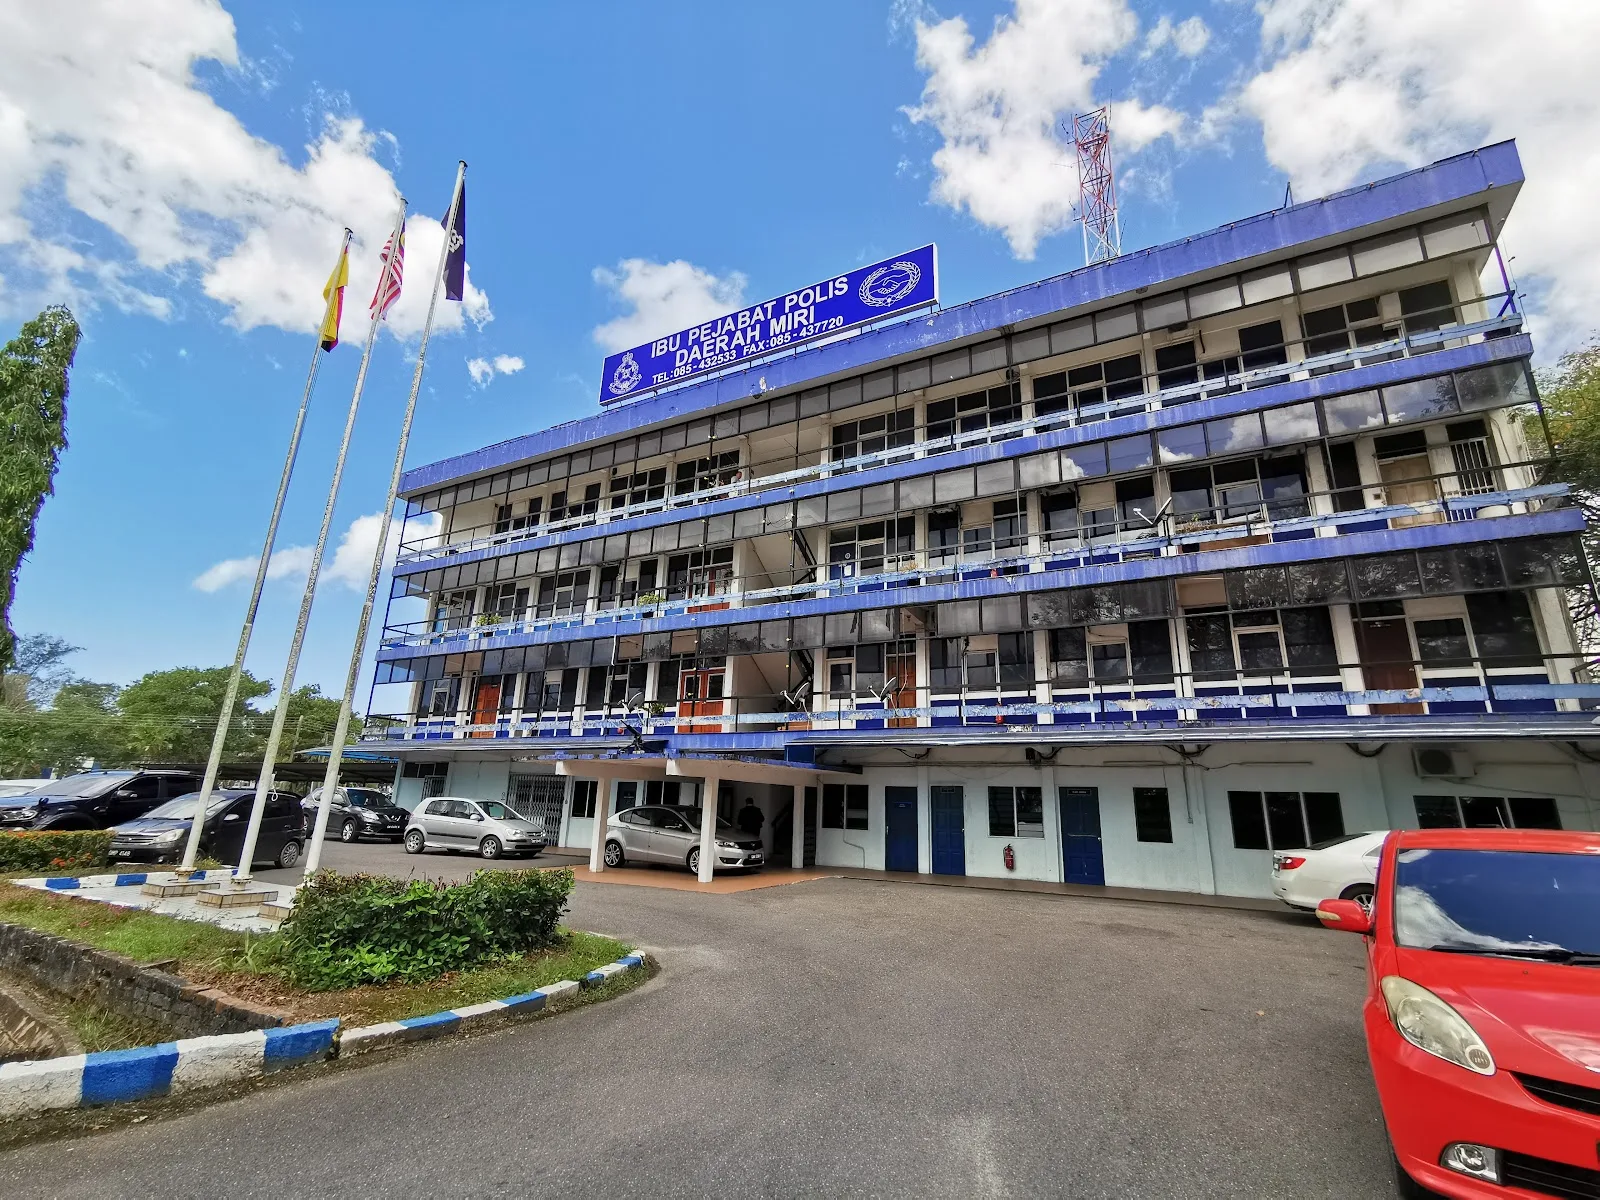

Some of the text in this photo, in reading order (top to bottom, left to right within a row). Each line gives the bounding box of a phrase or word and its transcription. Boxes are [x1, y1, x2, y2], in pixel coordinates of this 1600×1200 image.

[651, 277, 849, 358] IBU PEJABAT POLIS
[675, 306, 815, 367] DAERAH MIRI
